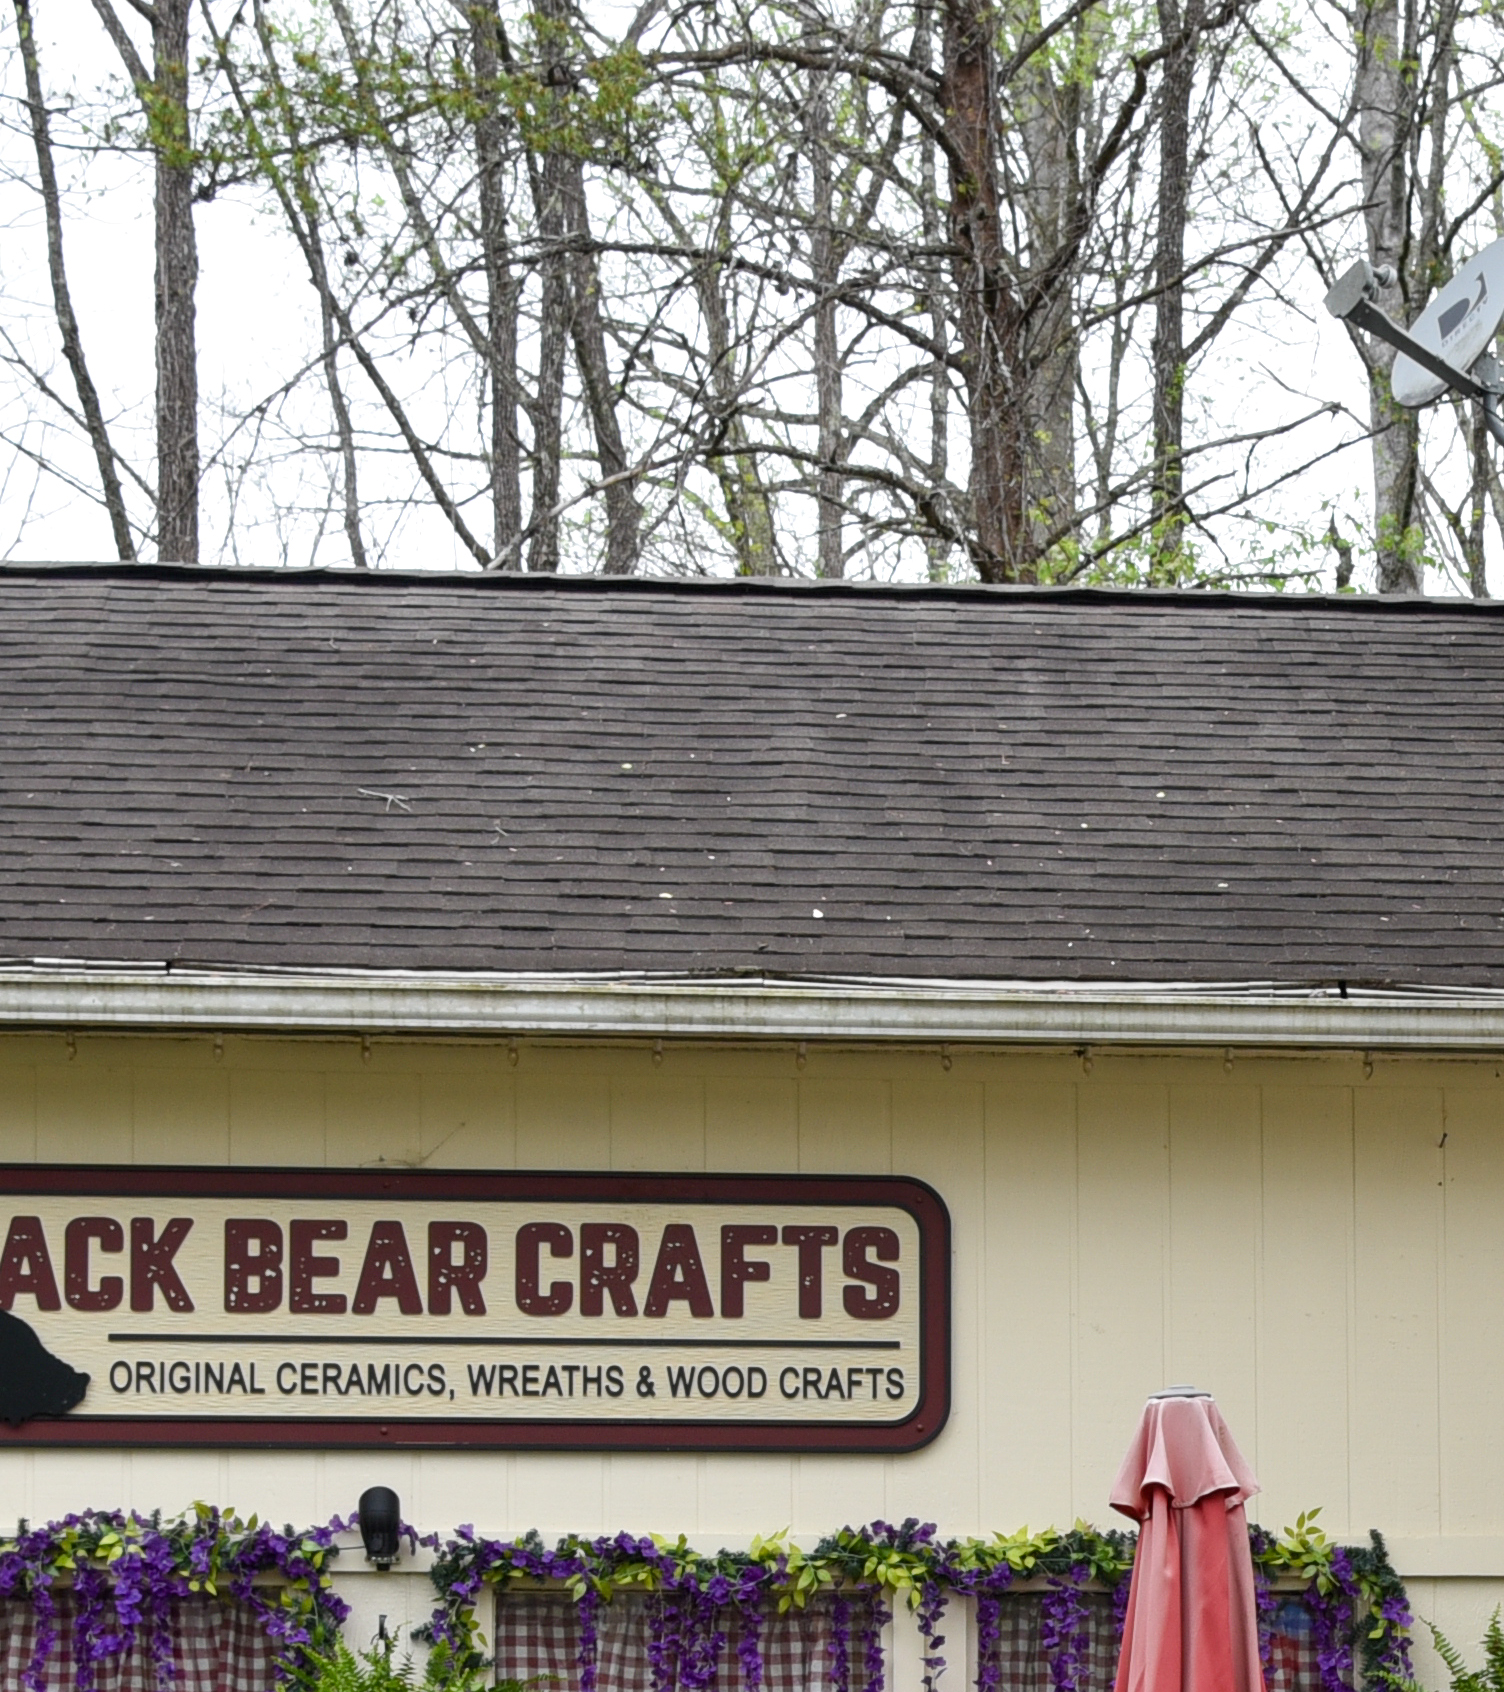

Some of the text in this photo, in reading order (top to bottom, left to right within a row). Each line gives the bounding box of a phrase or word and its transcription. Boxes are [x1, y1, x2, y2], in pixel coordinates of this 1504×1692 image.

[224, 1218, 487, 1317] BEAR
[515, 1222, 901, 1320] CRAFTS
[109, 1361, 905, 1401] ORIGINAL CERAMICS, WREATHS & WOOD CRAFTS
